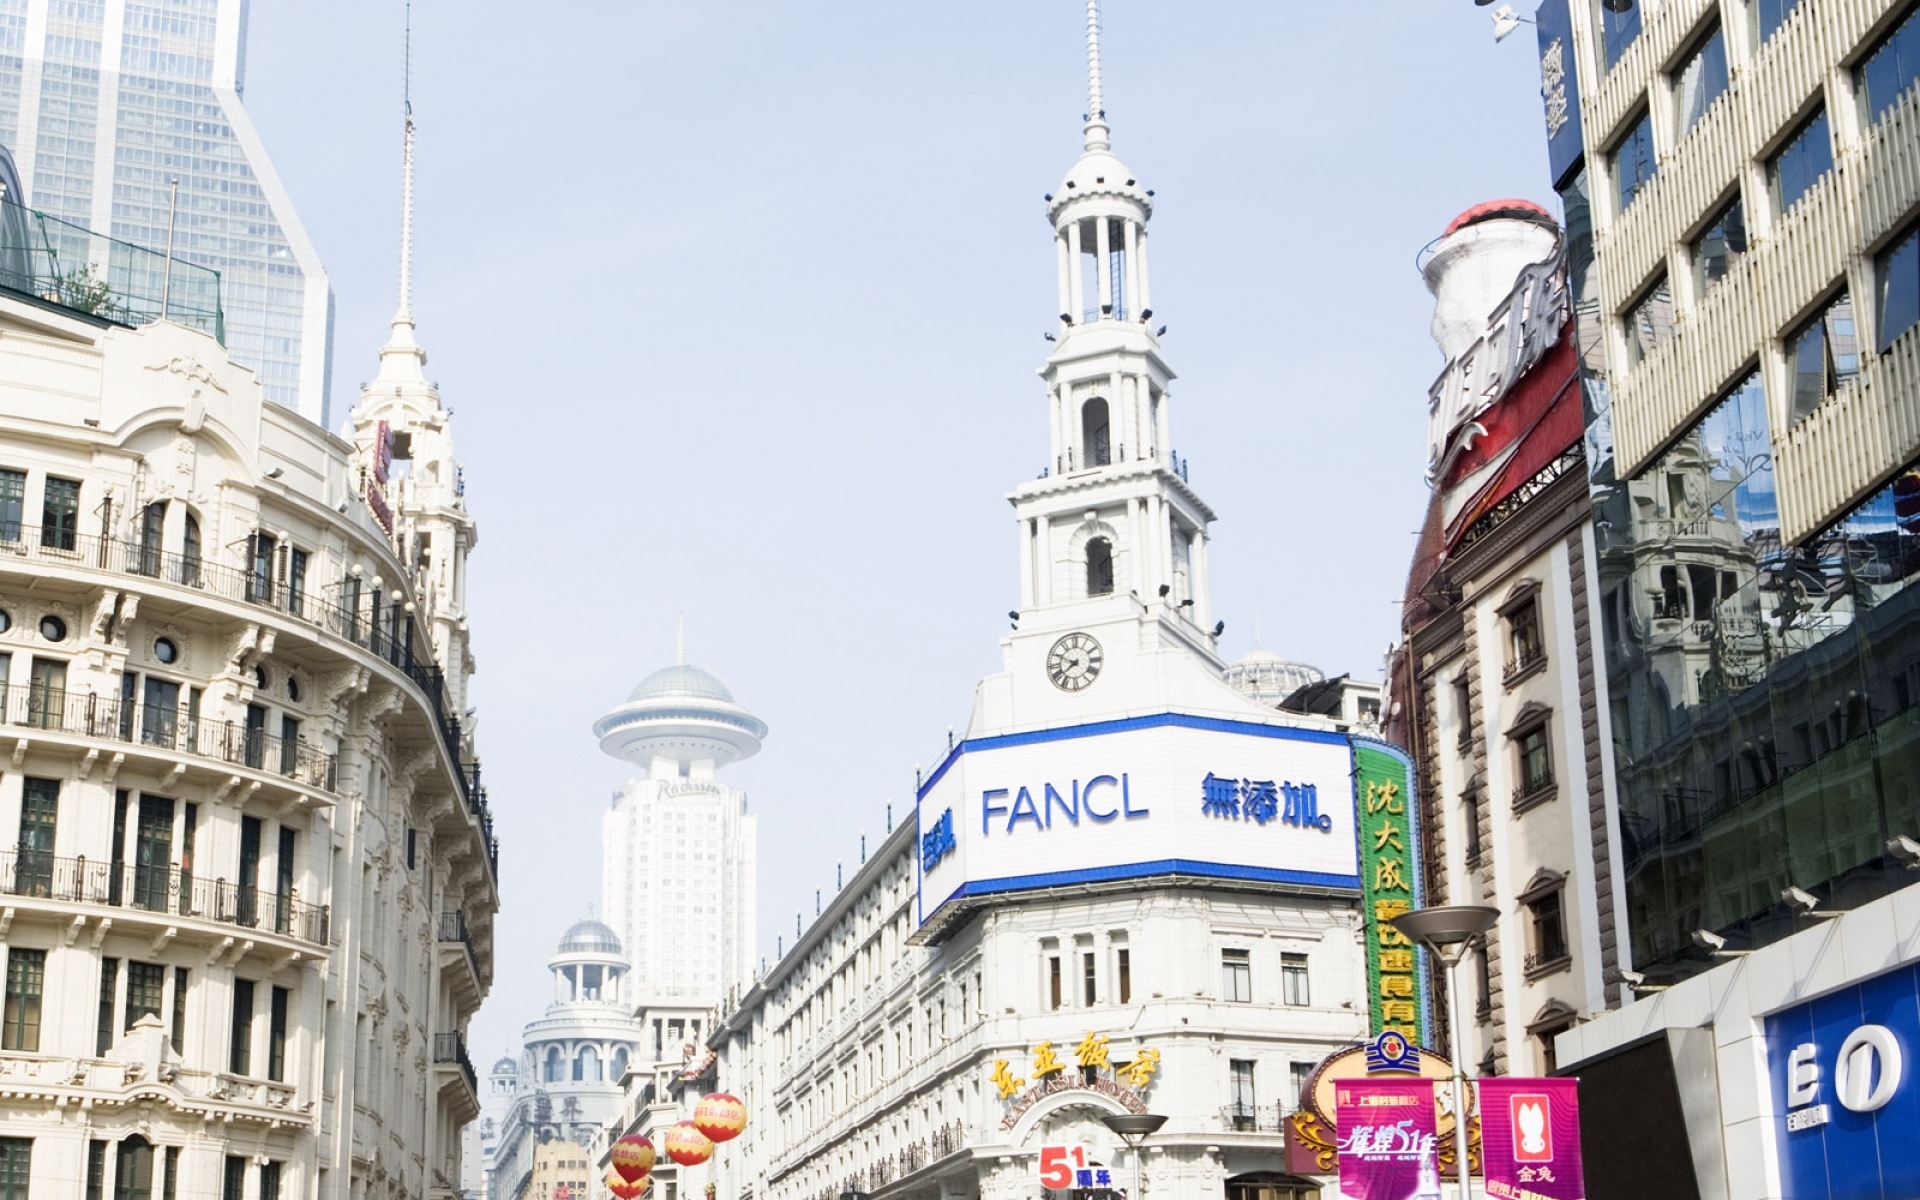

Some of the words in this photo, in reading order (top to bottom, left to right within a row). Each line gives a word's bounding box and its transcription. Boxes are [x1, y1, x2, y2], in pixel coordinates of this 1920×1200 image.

[982, 773, 1150, 836] FANCL
[1001, 1085, 1043, 1129] EAST
[1046, 1074, 1089, 1094] ASIA
[1095, 1075, 1149, 1115] HOTEL
